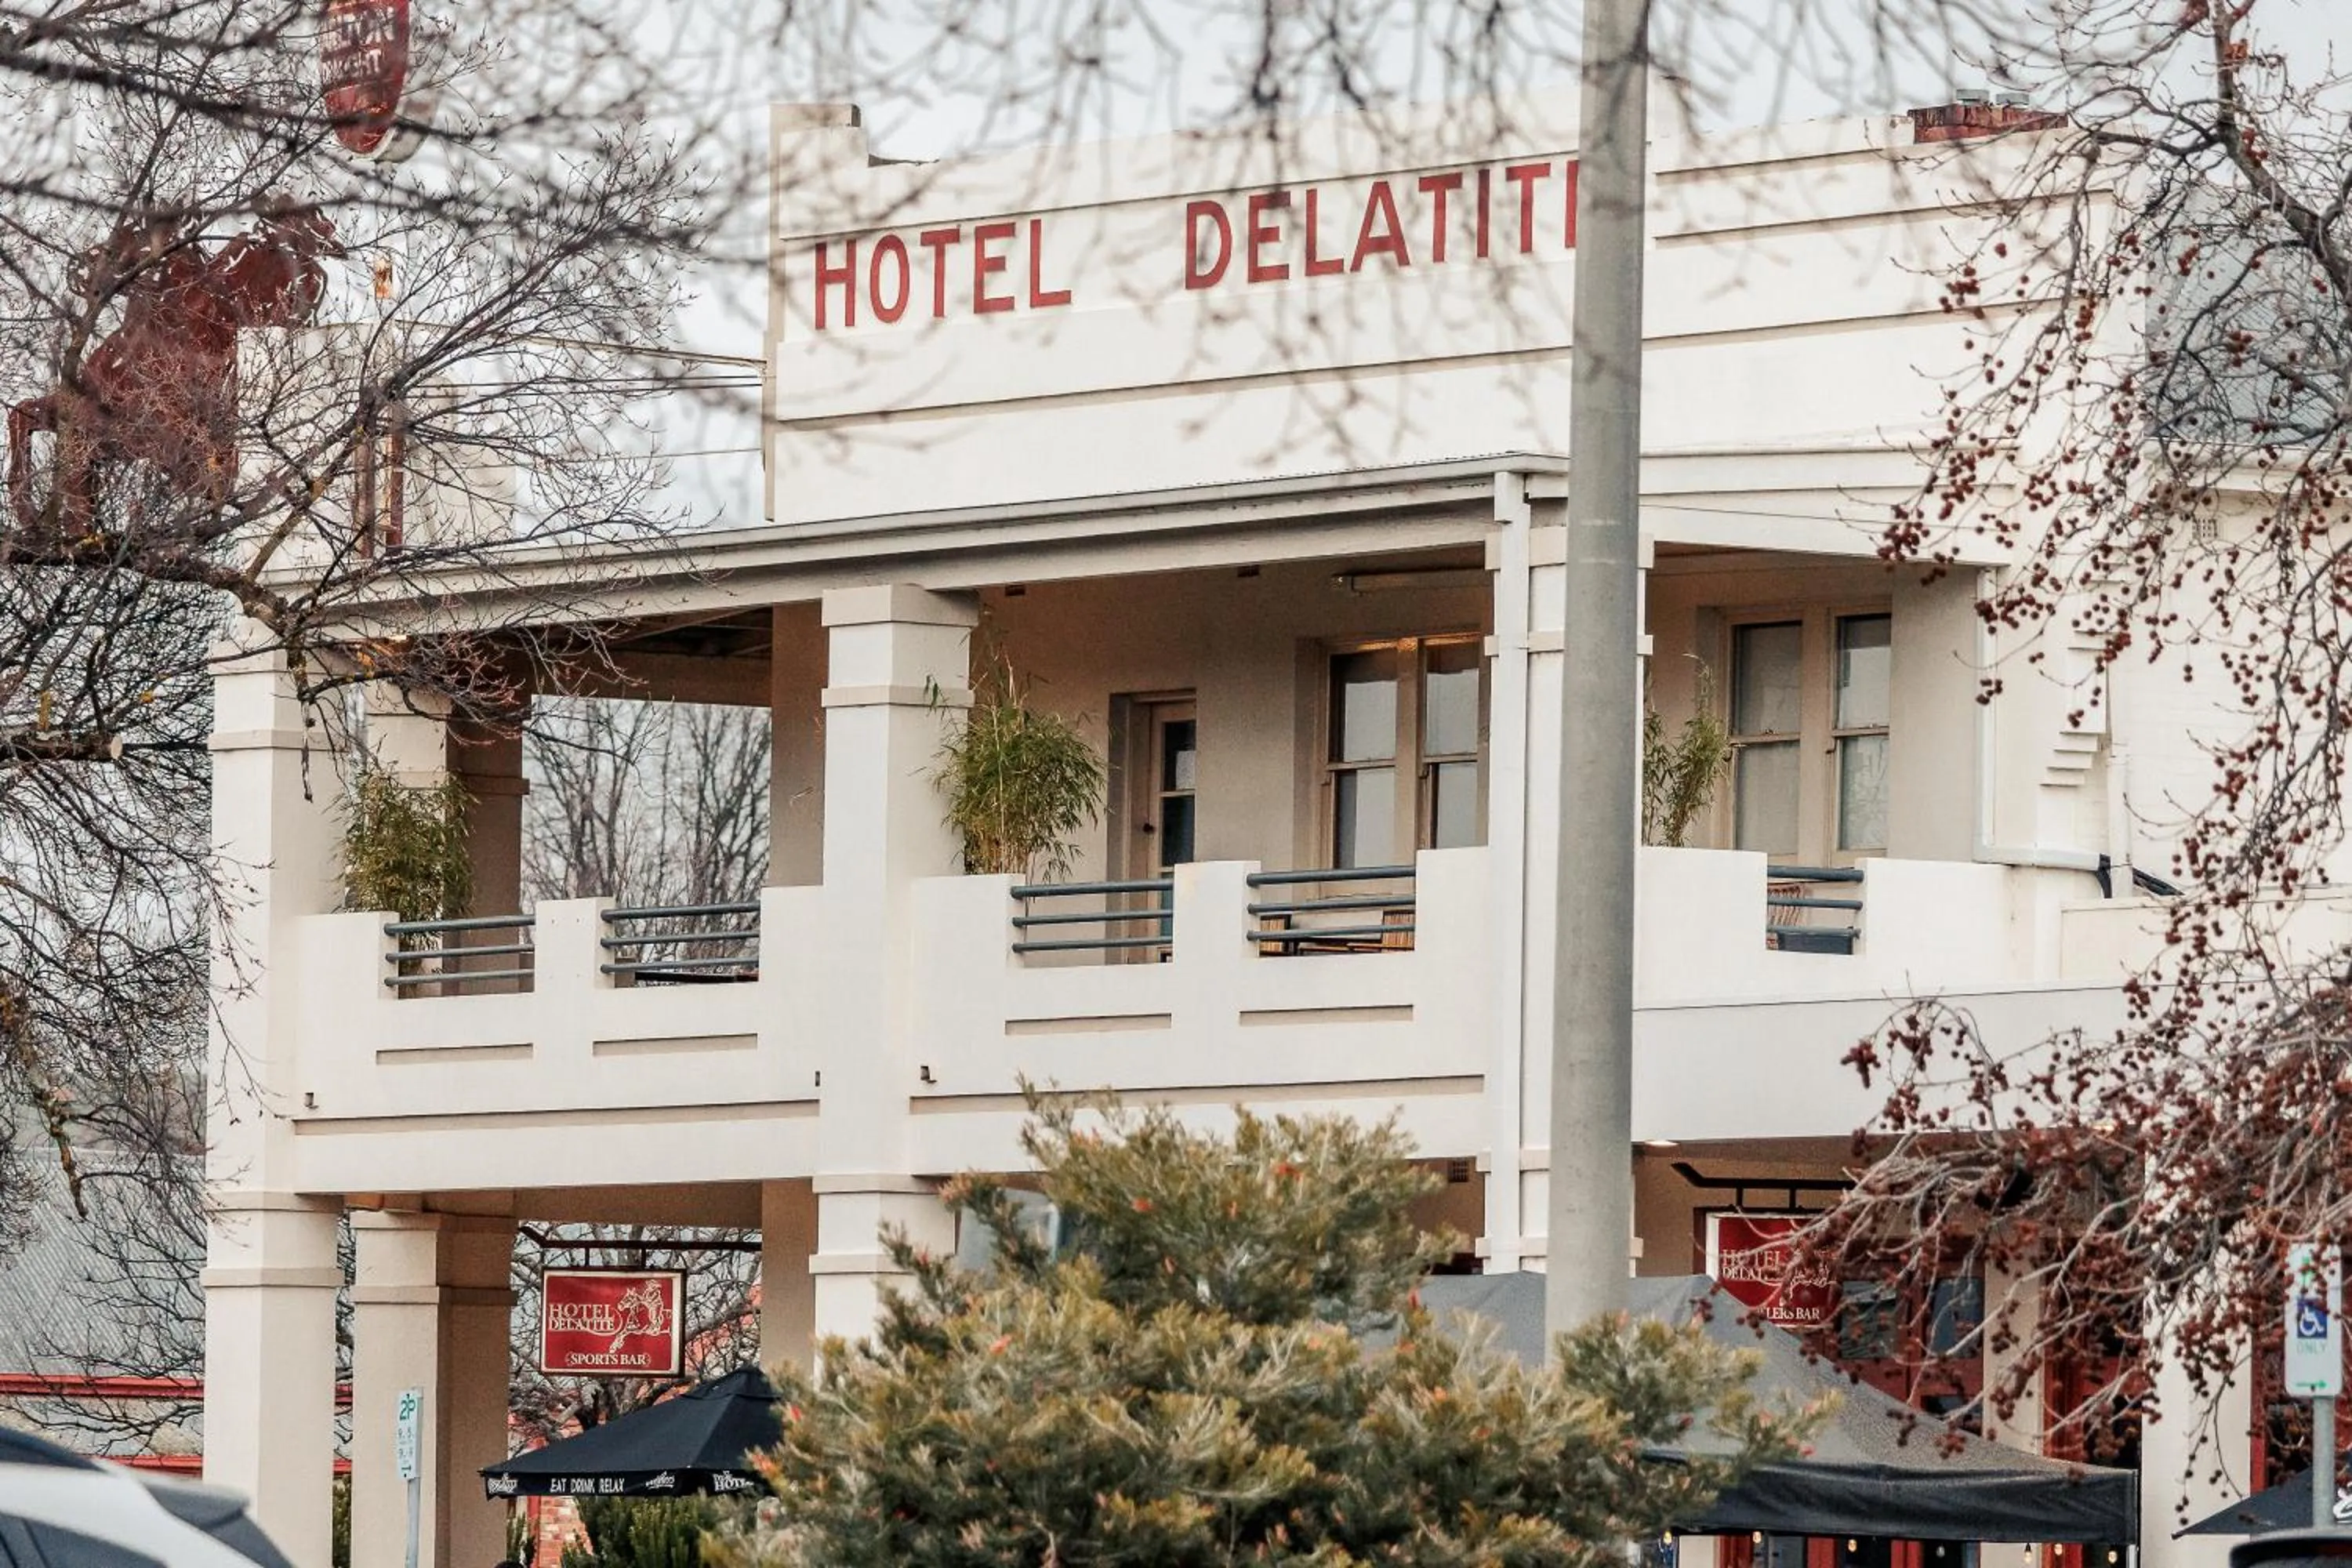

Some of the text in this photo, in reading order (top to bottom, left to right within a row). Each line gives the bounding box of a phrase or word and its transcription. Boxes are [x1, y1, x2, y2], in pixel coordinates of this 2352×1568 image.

[815, 219, 1072, 330] HOTEL
[549, 1304, 615, 1318] HOTEL
[1796, 1307, 1820, 1319] BAR
[549, 1318, 615, 1330] DELATITE
[570, 1354, 646, 1365] SPORTS BAR
[400, 1399, 416, 1421] 2P
[550, 1478, 625, 1493] EAT DRINK RELAX
